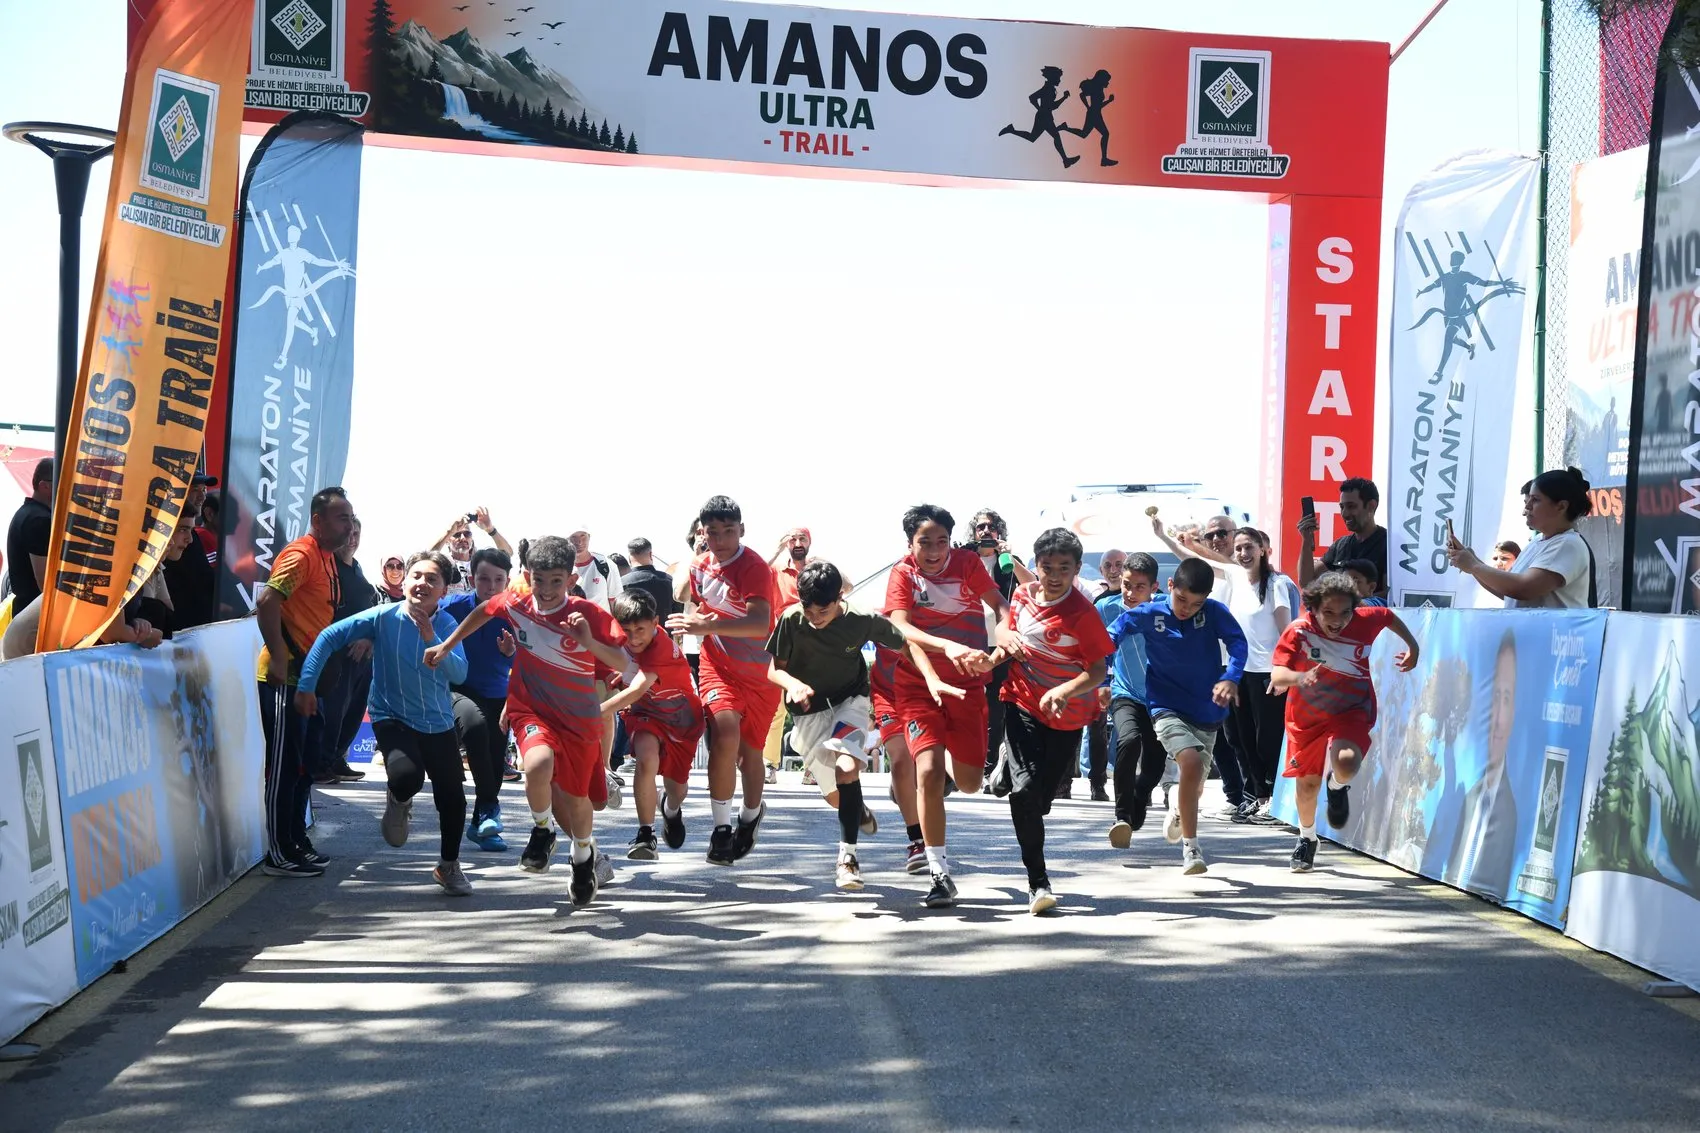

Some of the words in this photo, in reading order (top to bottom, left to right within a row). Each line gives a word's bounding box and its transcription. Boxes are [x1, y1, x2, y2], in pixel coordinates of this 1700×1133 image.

[270, 52, 327, 67] OSMANİYE
[647, 12, 988, 99] AMANOS
[244, 90, 273, 106] LIŞAN
[274, 91, 291, 107] BİR
[292, 92, 362, 113] BELEDİYECİLİK
[246, 78, 266, 89] PROJE
[267, 79, 277, 89] VE
[277, 79, 303, 91] HİZMET
[304, 81, 345, 93] ÜRETEBİLEN
[760, 91, 875, 131] ULTRA
[1203, 121, 1253, 132] OSMANİYE
[778, 131, 854, 157] TRAIL
[1180, 147, 1199, 156] PROJE
[1200, 148, 1208, 156] VE
[1208, 148, 1231, 156] HİZMET
[1232, 147, 1268, 157] ÜRETEBİLEN
[152, 161, 196, 183] OSMANİYE
[1168, 158, 1204, 173] ÇALIŞAN
[1205, 157, 1220, 172] BİR
[1221, 157, 1283, 174] BELEDİYECİLİK
[149, 211, 161, 229] BİR
[160, 214, 221, 244] BELEDİYECİLİK
[155, 297, 223, 432] TRAİL
[1307, 236, 1354, 547] START
[286, 364, 312, 543] SMANİYE
[55, 372, 137, 608] AMANOS
[255, 375, 282, 572] MARATON
[1399, 391, 1437, 575] MARATON
[1430, 379, 1466, 575] OSMANİYE
[1154, 615, 1166, 633] 5
[57, 656, 151, 798] AMANOS
